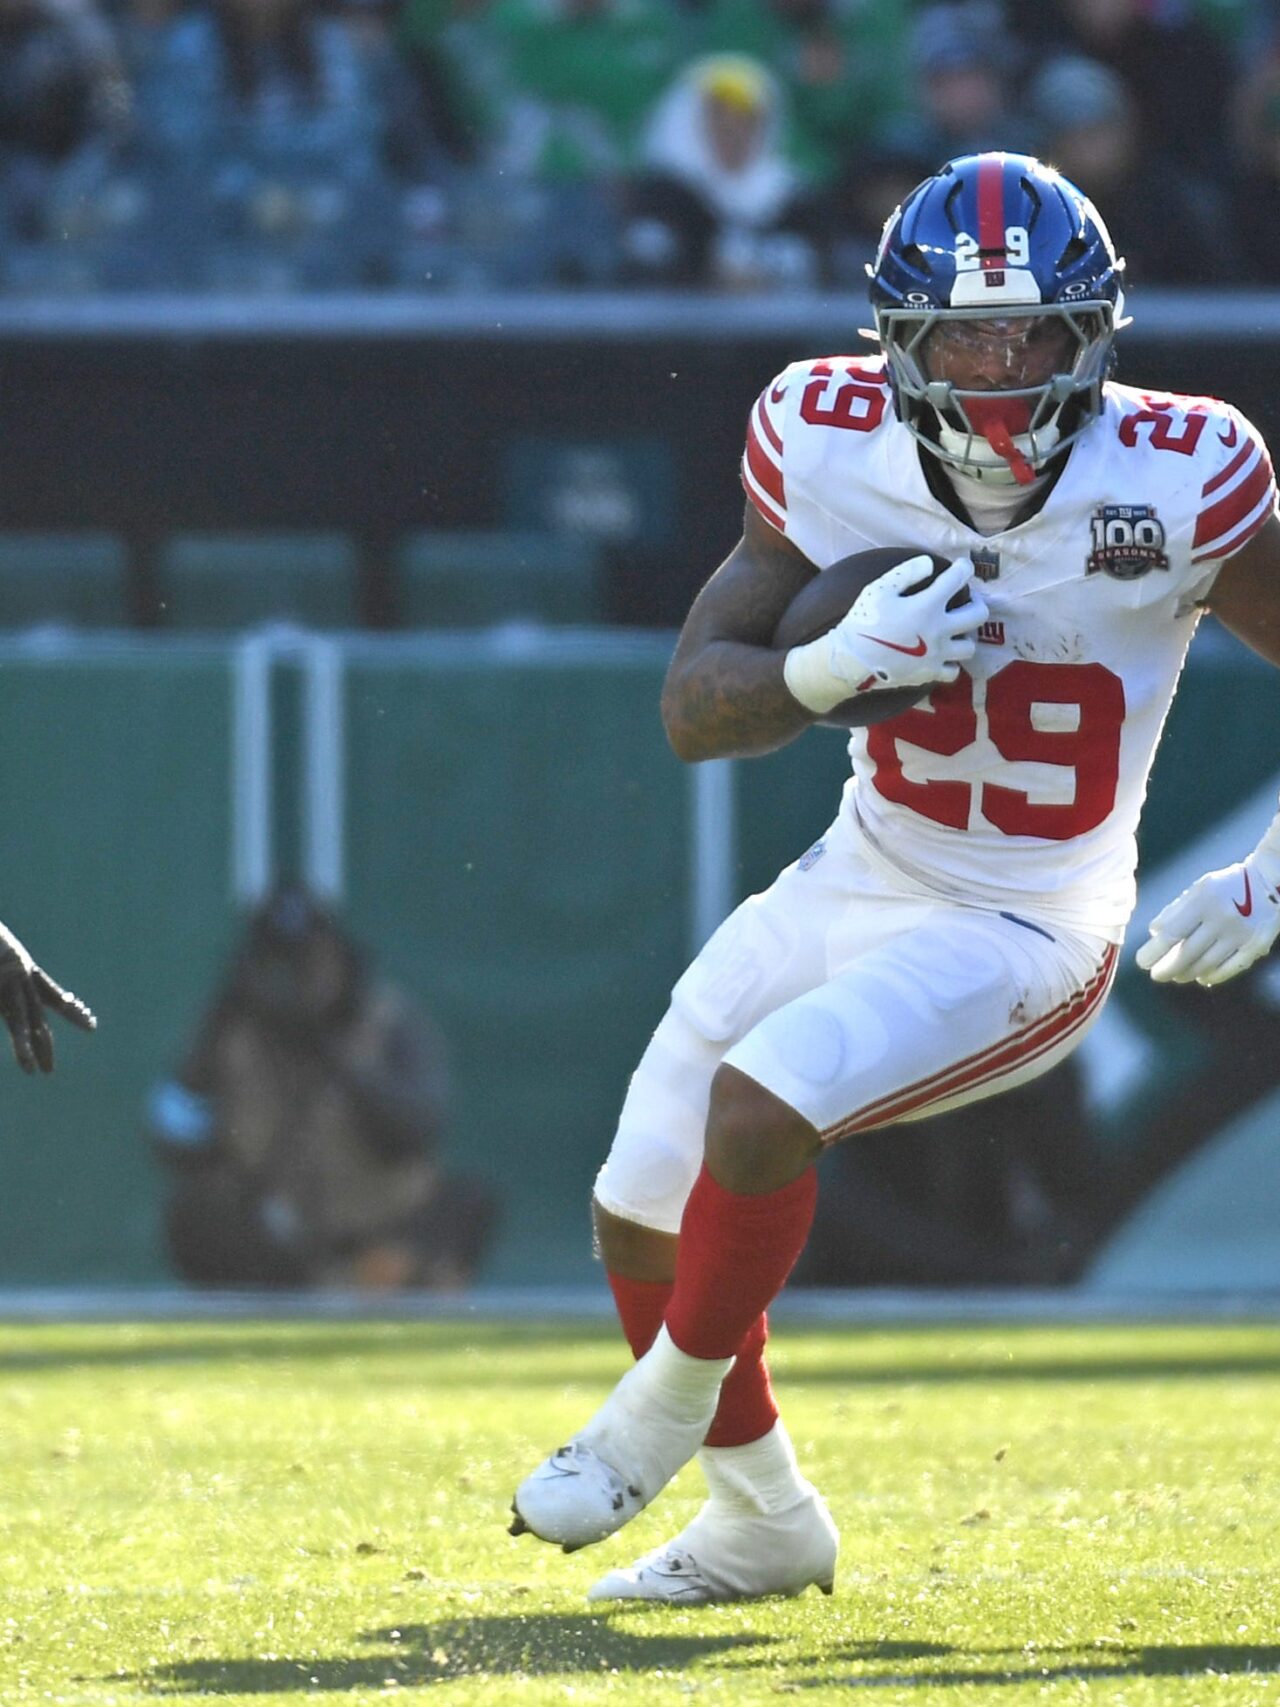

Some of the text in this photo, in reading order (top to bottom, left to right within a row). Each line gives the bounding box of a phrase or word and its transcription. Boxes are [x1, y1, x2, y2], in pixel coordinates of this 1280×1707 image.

[955, 226, 1029, 272] 29
[1118, 395, 1208, 456] 2
[1091, 519, 1163, 551] 100
[1097, 547, 1157, 560] SEASONS
[866, 659, 1126, 841] 29
